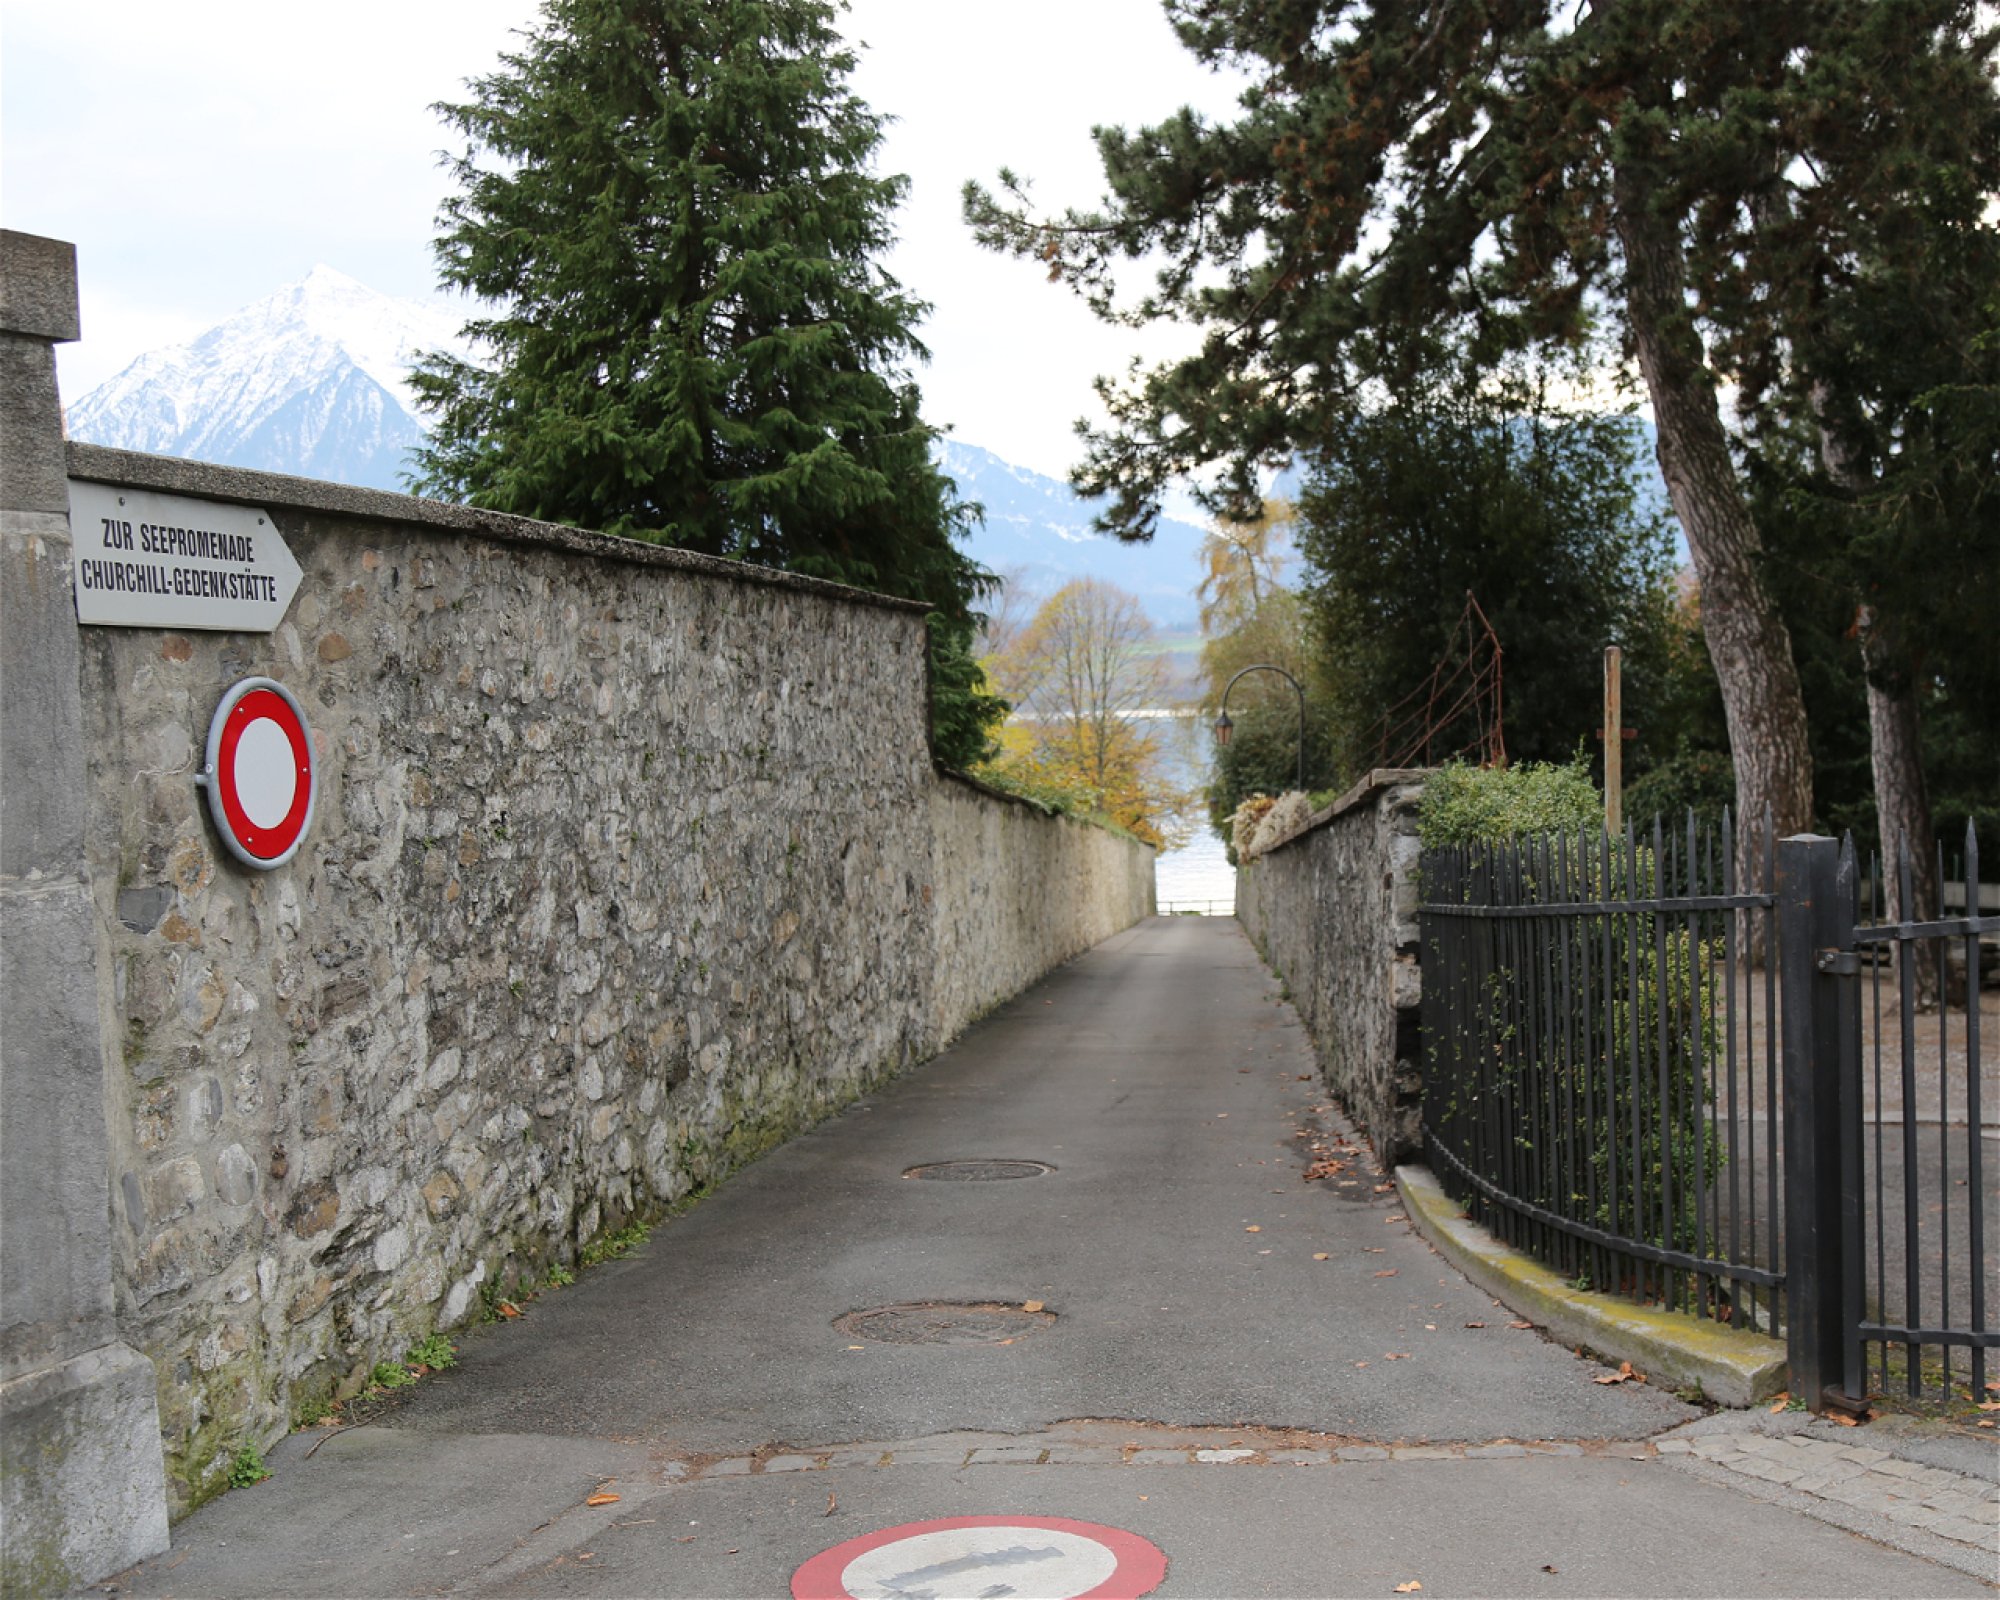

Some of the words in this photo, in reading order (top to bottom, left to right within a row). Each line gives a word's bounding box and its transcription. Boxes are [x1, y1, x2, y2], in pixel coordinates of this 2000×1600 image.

[101, 518, 134, 551] ZUR
[140, 523, 254, 563] SEEPROMENADE
[81, 559, 277, 602] CHURCHILL-GEDENKSTÄTTE
